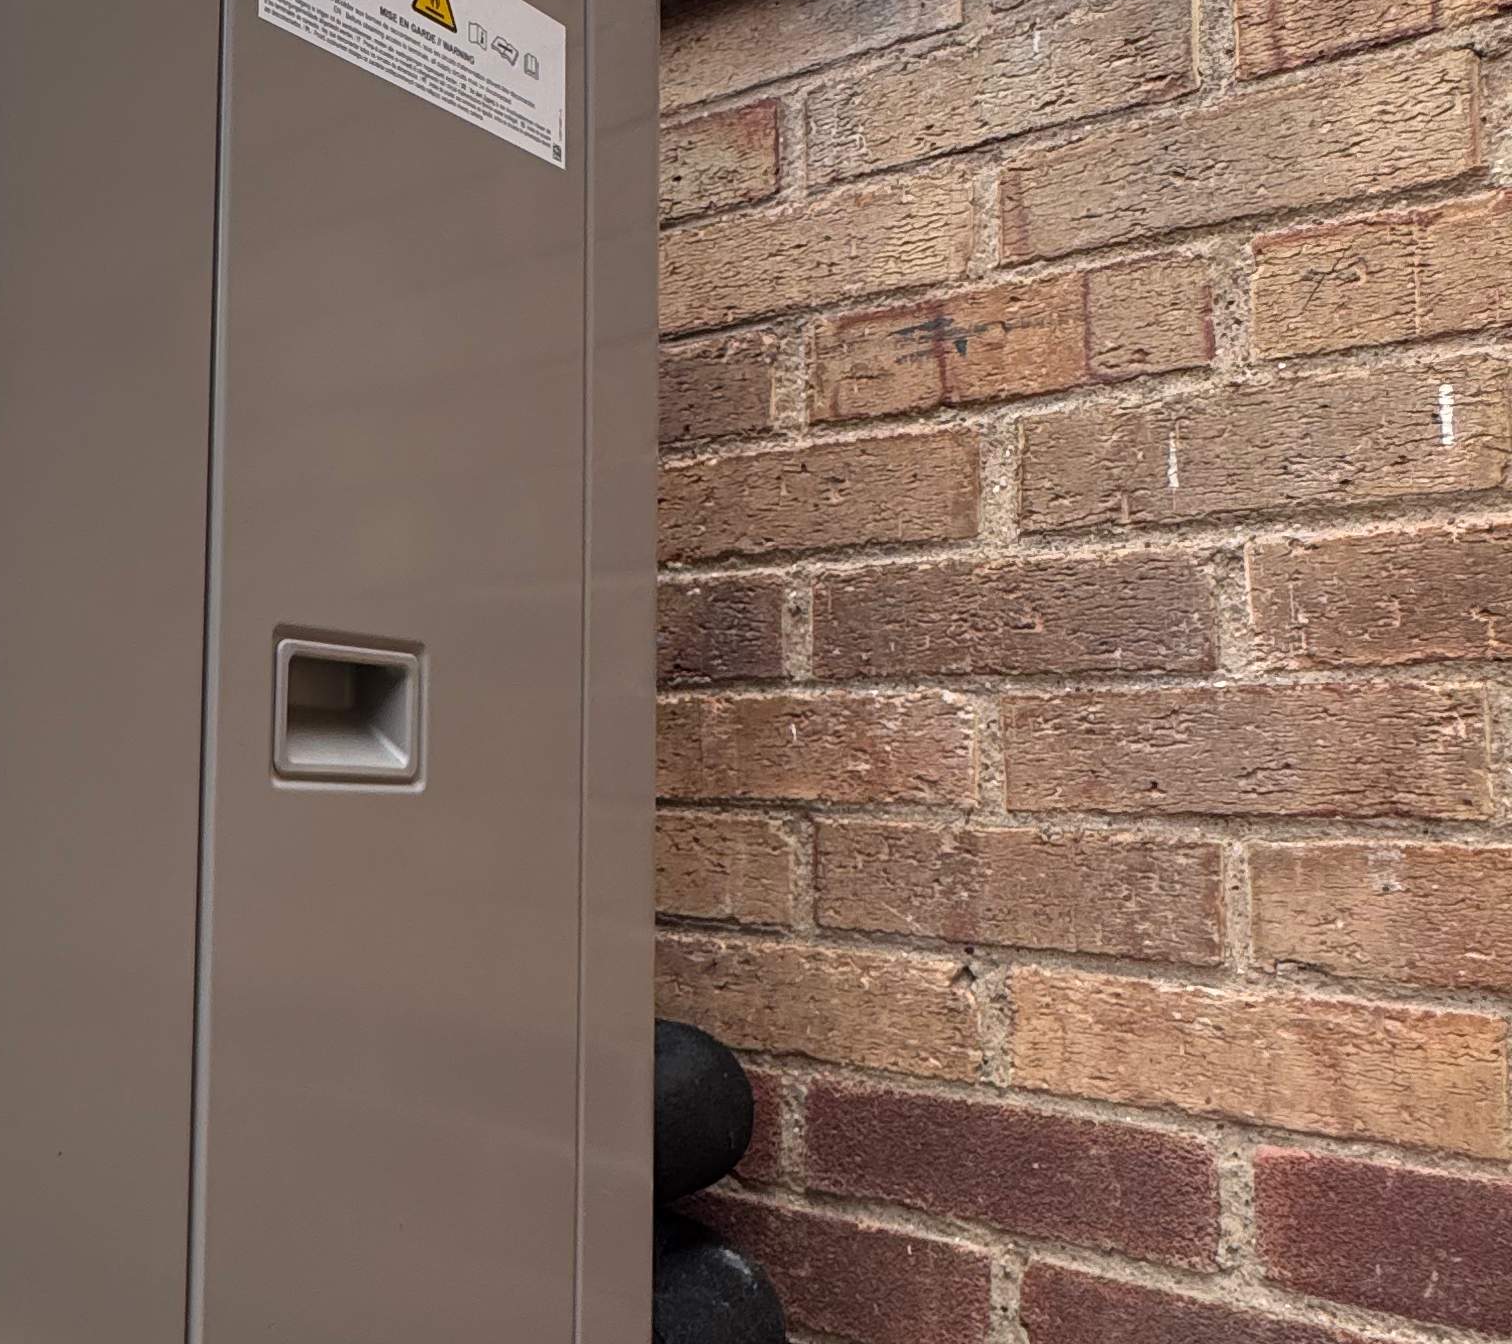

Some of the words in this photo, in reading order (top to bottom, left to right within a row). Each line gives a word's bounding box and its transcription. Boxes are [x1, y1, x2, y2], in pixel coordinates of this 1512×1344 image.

[379, 5, 398, 24] MISE
[399, 16, 409, 29] EN
[411, 23, 436, 44] GARDE
[443, 40, 475, 65] WARNING
